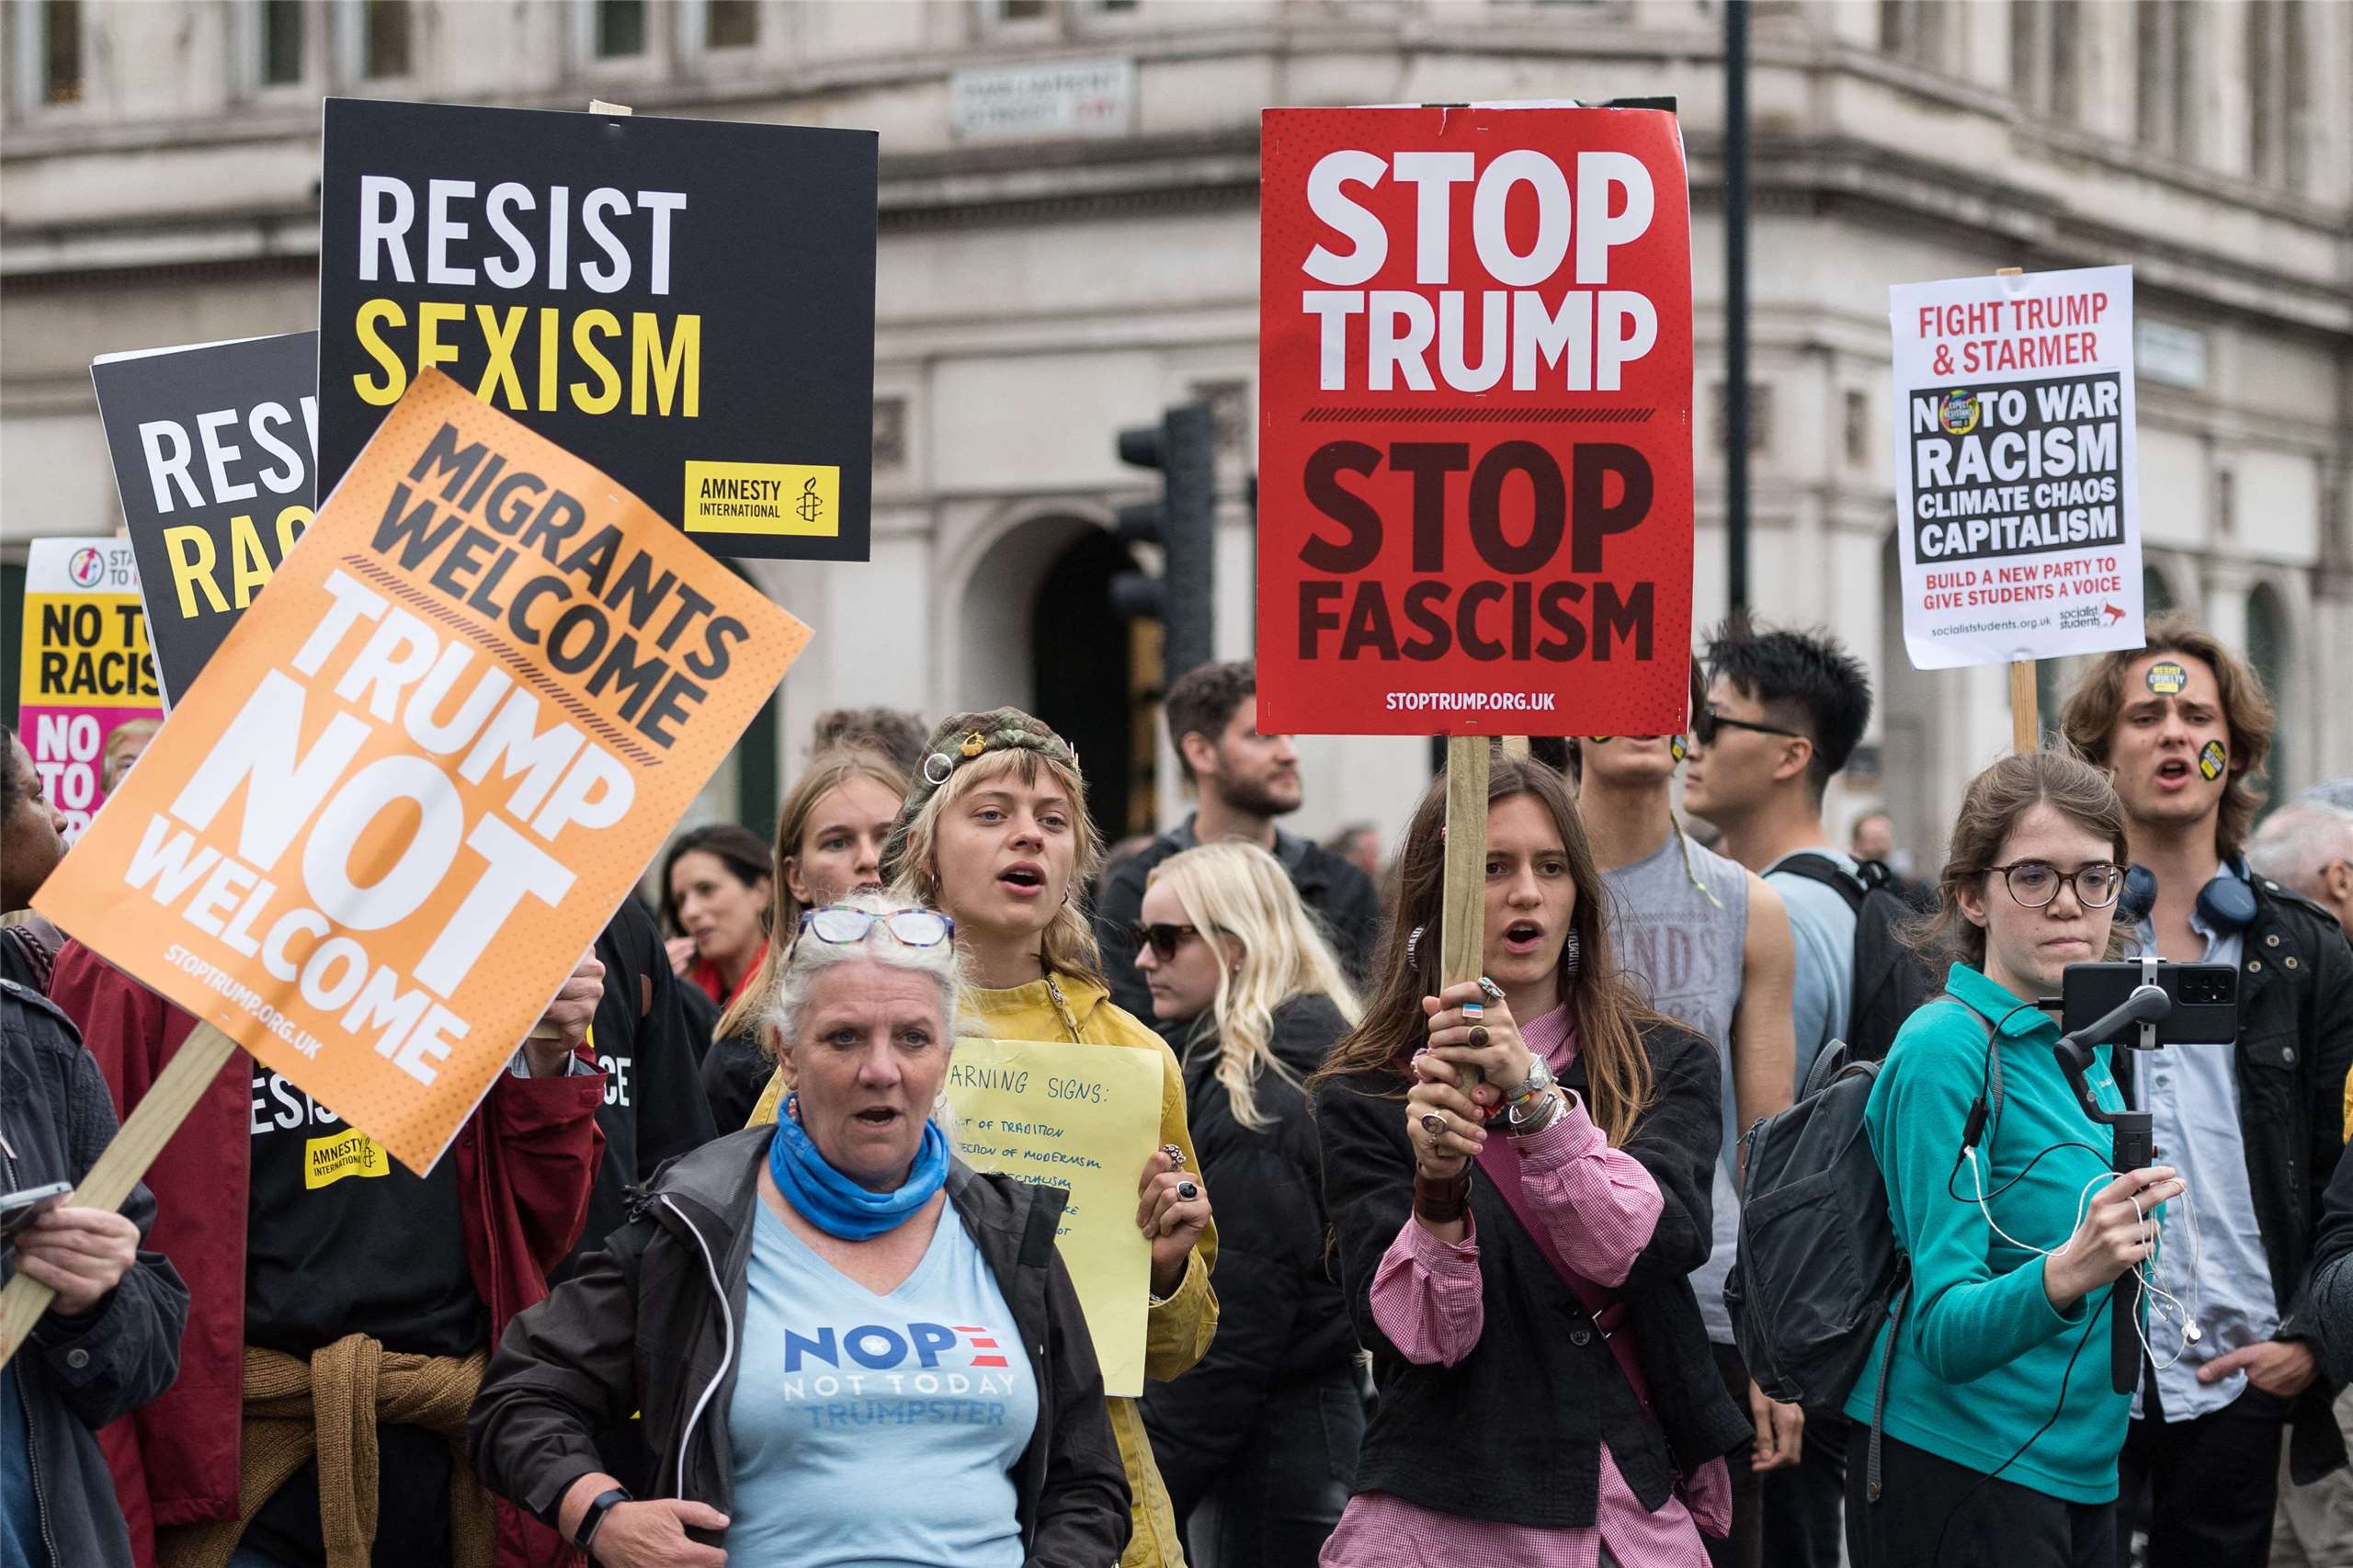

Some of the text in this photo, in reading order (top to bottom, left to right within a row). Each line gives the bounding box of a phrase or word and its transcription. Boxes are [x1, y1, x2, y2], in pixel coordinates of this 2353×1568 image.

[359, 175, 688, 295] RESIST
[1301, 149, 1655, 287] STOP
[1919, 291, 2109, 338] FIGHT TRUMP
[352, 298, 701, 417] SEXISM
[1302, 290, 1658, 393] TRUMP
[1932, 343, 1955, 376] &
[1962, 332, 2098, 374] STARMER
[1977, 389, 2028, 428] TO
[2035, 381, 2119, 424] WAR
[1916, 422, 2118, 489] RACISM
[699, 503, 780, 518] INTERNATIONAL
[700, 478, 782, 501] AMNESTY
[1297, 439, 1654, 575] STOP
[1917, 476, 2117, 519] CLIMATE CHAOS
[408, 421, 751, 681] MIGRANTS
[1920, 505, 2118, 558] CAPITALISM
[109, 569, 129, 585] TO
[1923, 575, 2121, 611] GIVE STUDENTS A VOICE
[1926, 557, 2117, 590] BUILD A NEW PARTY TO
[41, 603, 151, 648] NO T
[369, 482, 709, 750] WELCOME
[1298, 579, 1654, 663] FASCISM
[1931, 616, 2052, 637] socialiststudents.org.uk
[2059, 605, 2099, 620] socialist
[2059, 616, 2101, 630] students
[40, 652, 161, 696] RACIS
[290, 567, 636, 843] TRUMP
[1385, 691, 1556, 711] STOPTRUMP.ORG.UK
[37, 713, 101, 763] NO
[38, 761, 96, 811] TO
[168, 667, 578, 1001] NOT
[123, 812, 472, 1087] WELCOME
[164, 943, 324, 1061] STOPTRUMP.ORG.UK
[949, 1064, 1110, 1104] ARNING SIGNS:
[960, 1142, 997, 1155] ECTION
[1002, 1147, 1017, 1158] OF
[978, 1119, 994, 1130] OF
[1000, 1119, 1064, 1138] TRADITION
[313, 1138, 363, 1165] AMNESTY
[313, 1154, 362, 1177] INTERNATIONA
[783, 1322, 1009, 1373] NOPE
[783, 1372, 1016, 1402] NOT TODAY
[801, 1398, 1006, 1428] TRUMPSTER
